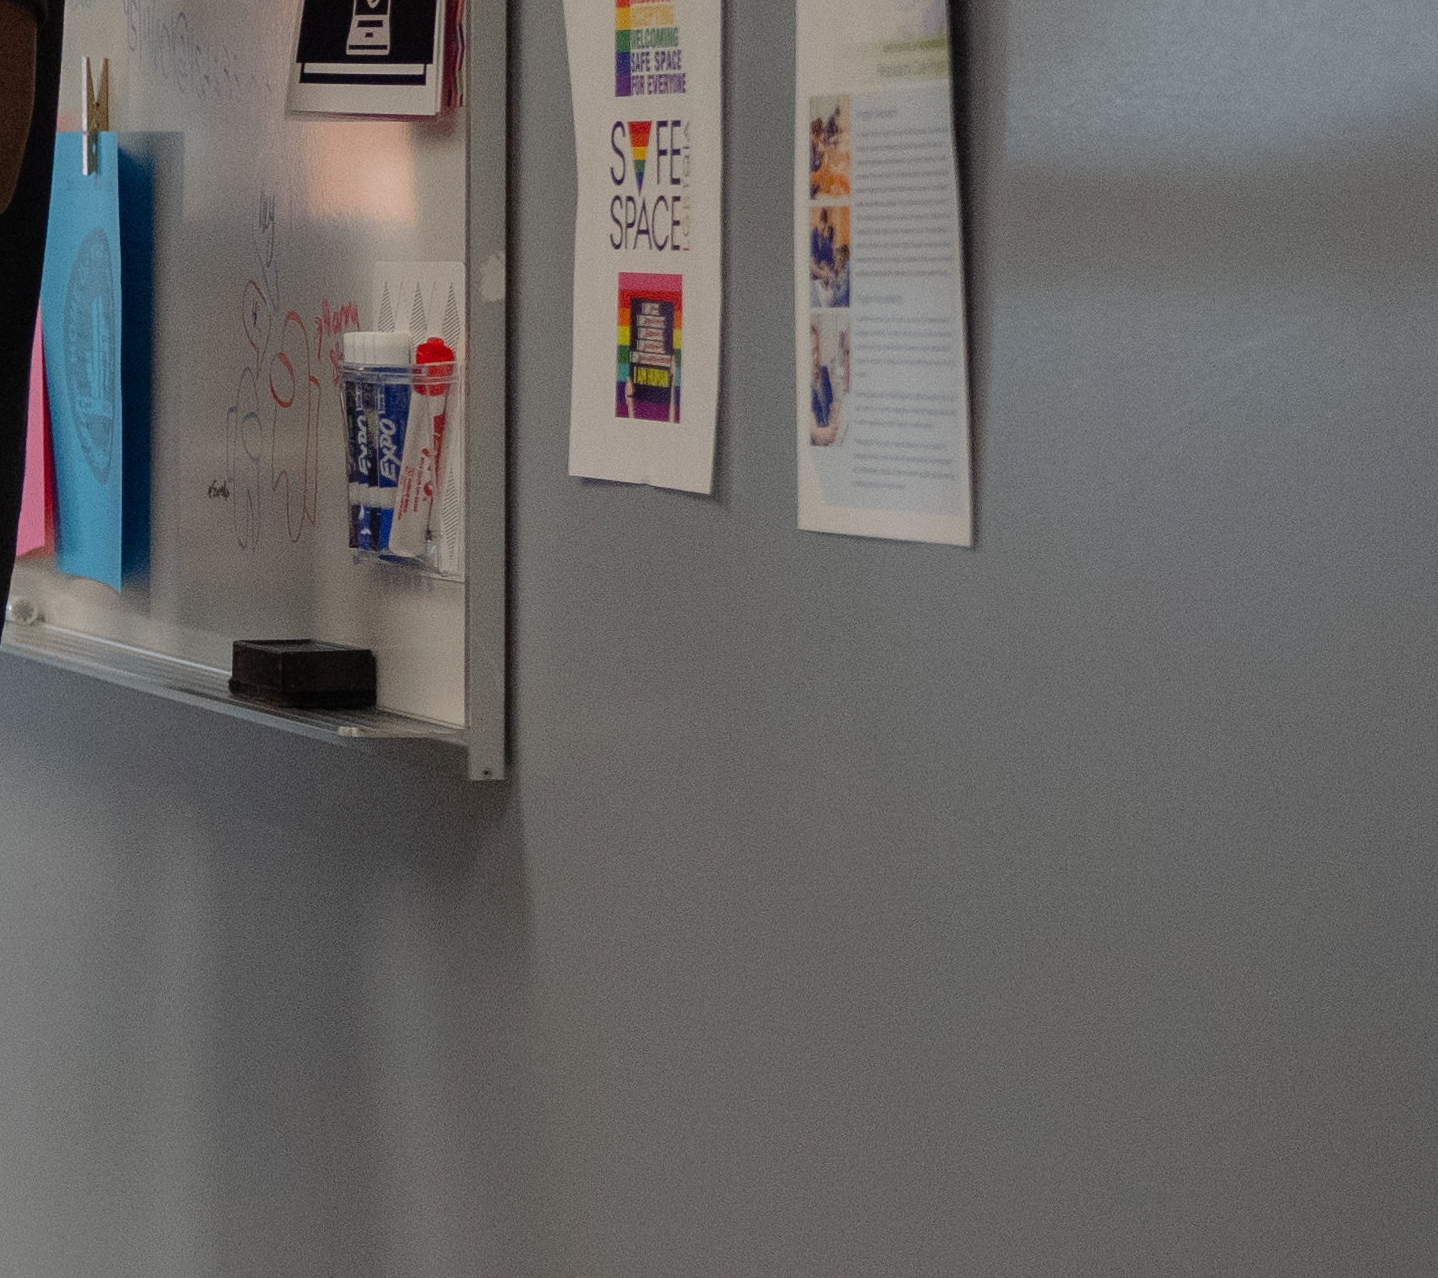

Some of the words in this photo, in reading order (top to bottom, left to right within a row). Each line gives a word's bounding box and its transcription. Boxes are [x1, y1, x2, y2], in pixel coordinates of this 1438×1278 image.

[630, 27, 679, 50] WELCOMING
[631, 51, 651, 72] SAFE
[654, 49, 682, 71] SPACE
[631, 74, 645, 95] FOR
[647, 72, 687, 95] EVERYONE
[609, 194, 682, 252] SPACE
[379, 418, 403, 482] EXPO
